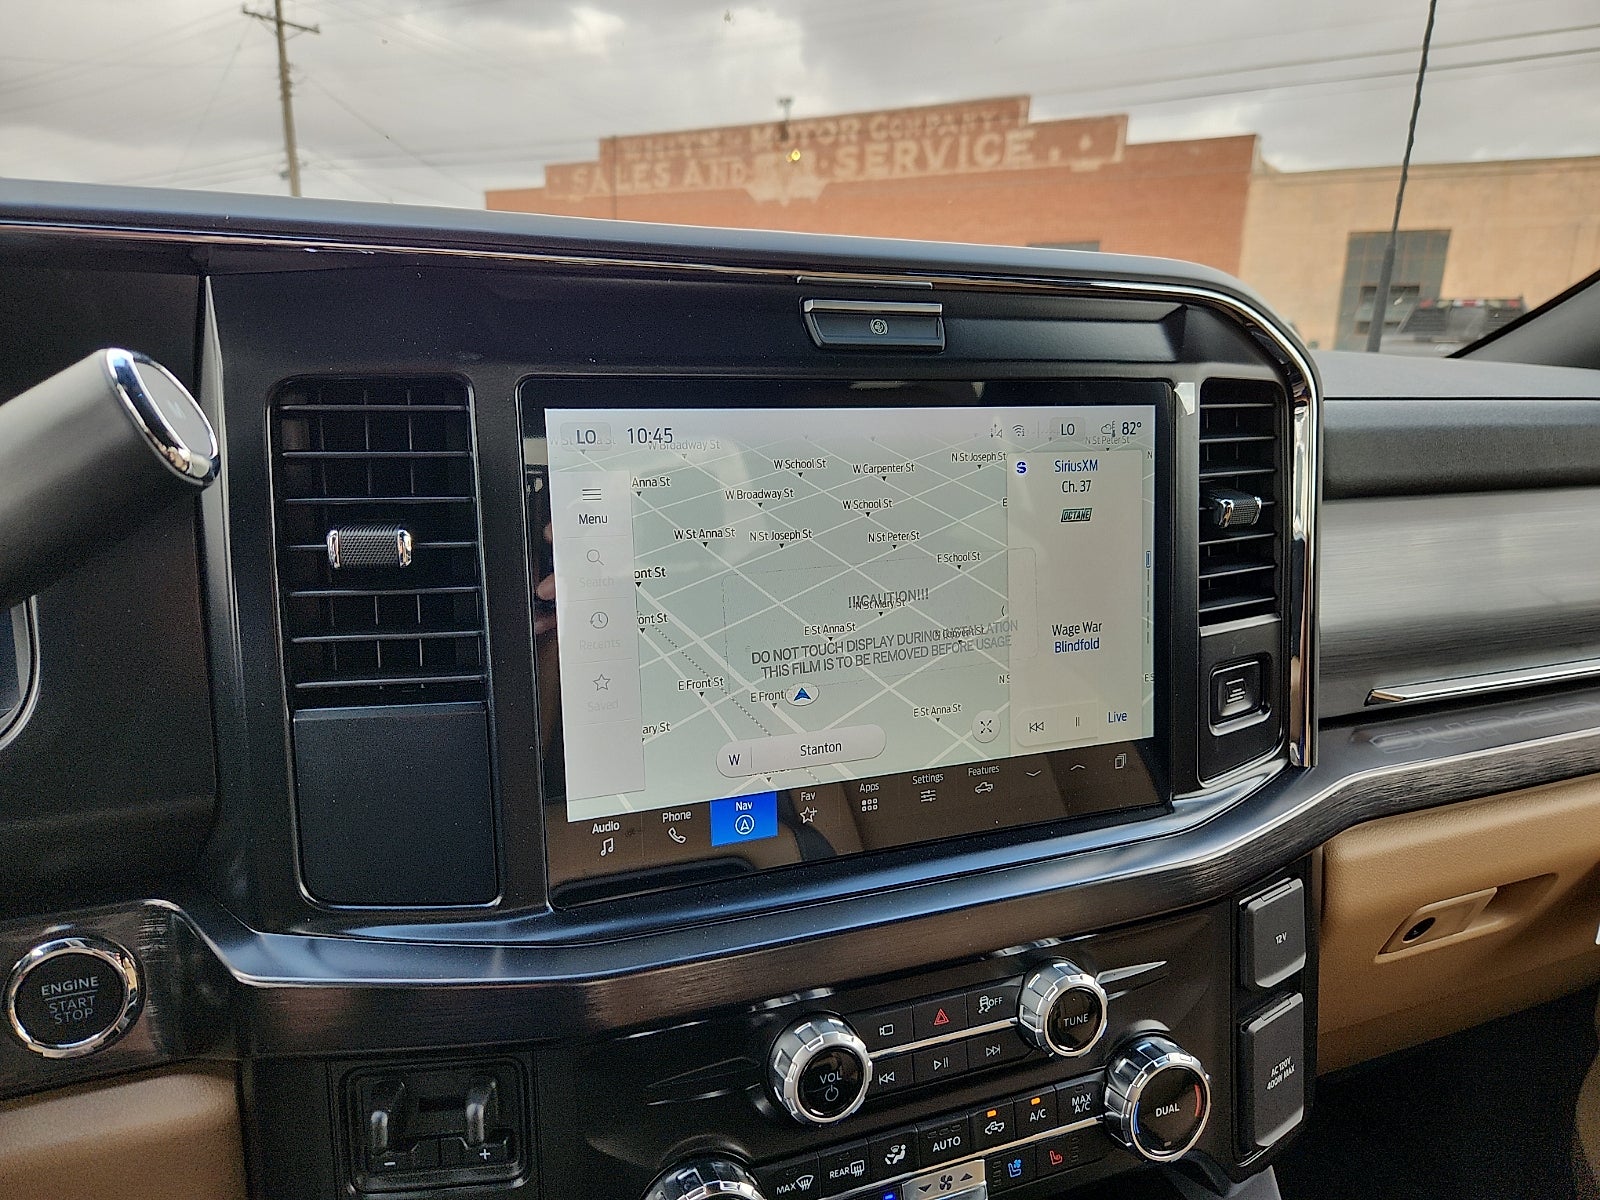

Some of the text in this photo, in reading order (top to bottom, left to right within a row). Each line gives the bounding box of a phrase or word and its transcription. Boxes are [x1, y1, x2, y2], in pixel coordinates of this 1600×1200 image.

[571, 159, 671, 197] SALES
[682, 157, 746, 190] AND
[833, 129, 1036, 177] SERVICE
[1061, 423, 1075, 435] LO
[1122, 421, 1142, 435] 82°
[576, 429, 596, 445] LO
[627, 427, 673, 445] 10:45
[710, 440, 721, 450] St
[773, 458, 827, 470] W School St
[951, 451, 1007, 464] N St Joseph St
[853, 462, 915, 476] W Carpenter St
[1054, 459, 1098, 472] SiriusXM
[632, 477, 671, 488] Anna St
[1061, 480, 1092, 493] Ch. 37
[725, 487, 794, 501] W Broadway St
[843, 498, 893, 510] W School St
[578, 513, 608, 525] Menu
[1063, 510, 1091, 521] OCTANE
[674, 527, 736, 540] W St Anna St
[750, 528, 813, 542] N St Joseph St
[868, 530, 920, 543] N St Peter St
[937, 552, 981, 564] E School St
[654, 567, 666, 578] St
[654, 612, 668, 624] St
[804, 623, 857, 636] E St Anna St
[1051, 621, 1103, 637] Wage War
[752, 652, 772, 665] DO
[773, 649, 800, 662] NOT
[801, 642, 844, 659] TOUCH
[846, 637, 896, 654] DISPLAY
[897, 630, 941, 647] DURING
[1054, 638, 1100, 653] Blindfold
[761, 634, 1012, 680] THIS FILM IS TO BE REMOVED BEFORE USAGE
[678, 677, 724, 690] E Front St
[751, 690, 785, 702] E Front
[913, 703, 962, 717] E St Anna St
[1108, 710, 1128, 723] Live
[659, 721, 671, 733] St
[800, 741, 842, 757] Stanton
[728, 754, 741, 766] W
[968, 764, 1000, 777] Features
[911, 772, 944, 786] Settings
[859, 782, 880, 794] Apps
[800, 791, 816, 803] Fav
[735, 800, 753, 811] Nav
[662, 809, 692, 823] Phone
[591, 820, 620, 835] Audio
[1275, 931, 1287, 945] 12V
[41, 976, 100, 996] ENGINE
[49, 996, 96, 1014] START
[988, 996, 1004, 1007] OFF
[55, 1007, 94, 1025] STOP
[1063, 1012, 1089, 1027] TUNE
[819, 1072, 843, 1085] VOL
[1071, 1093, 1092, 1107] MAX
[1074, 1101, 1092, 1114] A/C
[1155, 1102, 1181, 1118] DUAL
[1029, 1108, 1047, 1122] A/C
[932, 1136, 961, 1153] AUTO
[829, 1167, 851, 1180] REAR
[776, 1183, 797, 1196] MAX
